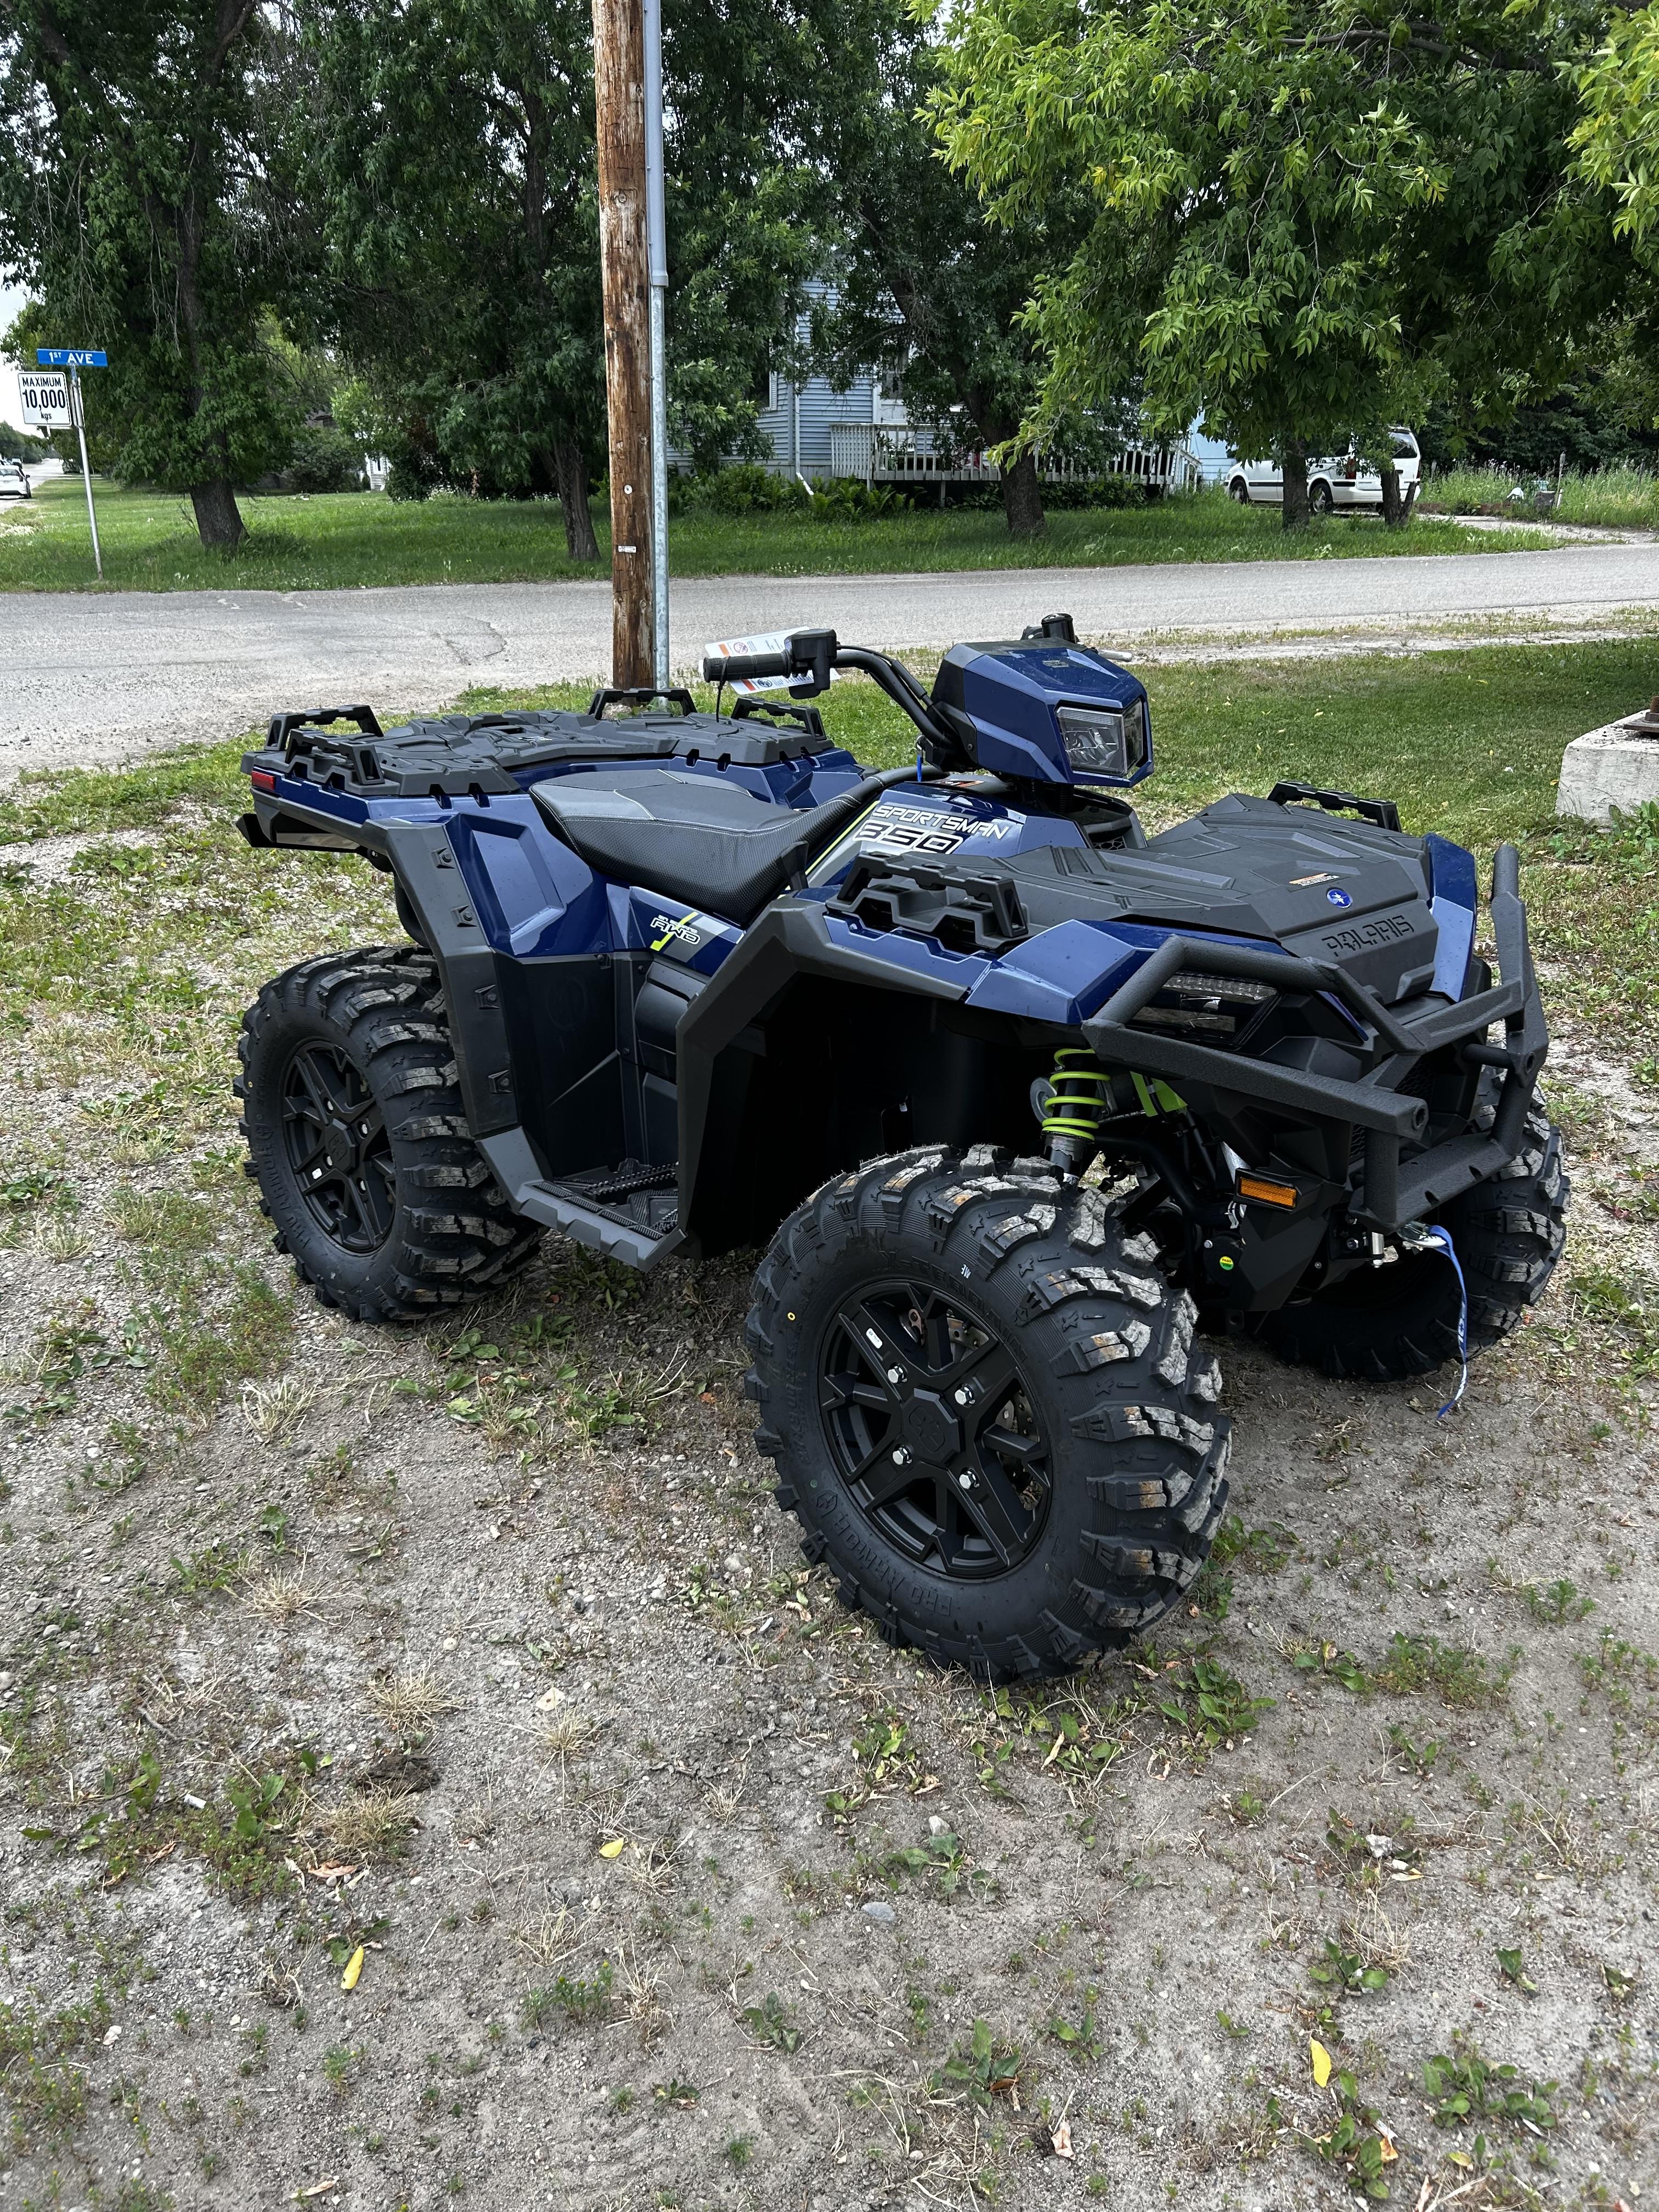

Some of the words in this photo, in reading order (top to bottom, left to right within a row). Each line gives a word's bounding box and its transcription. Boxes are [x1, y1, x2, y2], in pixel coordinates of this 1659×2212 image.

[67, 353, 94, 364] AVE
[22, 376, 61, 387] MAXIMUM
[22, 389, 66, 411] 10,000
[41, 411, 52, 421] kgs
[852, 819, 964, 855] 850
[871, 804, 1011, 840] SPORTSMAN
[650, 917, 701, 945] AWD
[1321, 915, 1415, 957] POLARIS
[833, 1511, 905, 1592] ARMOR
[909, 1583, 952, 1617] PRO
